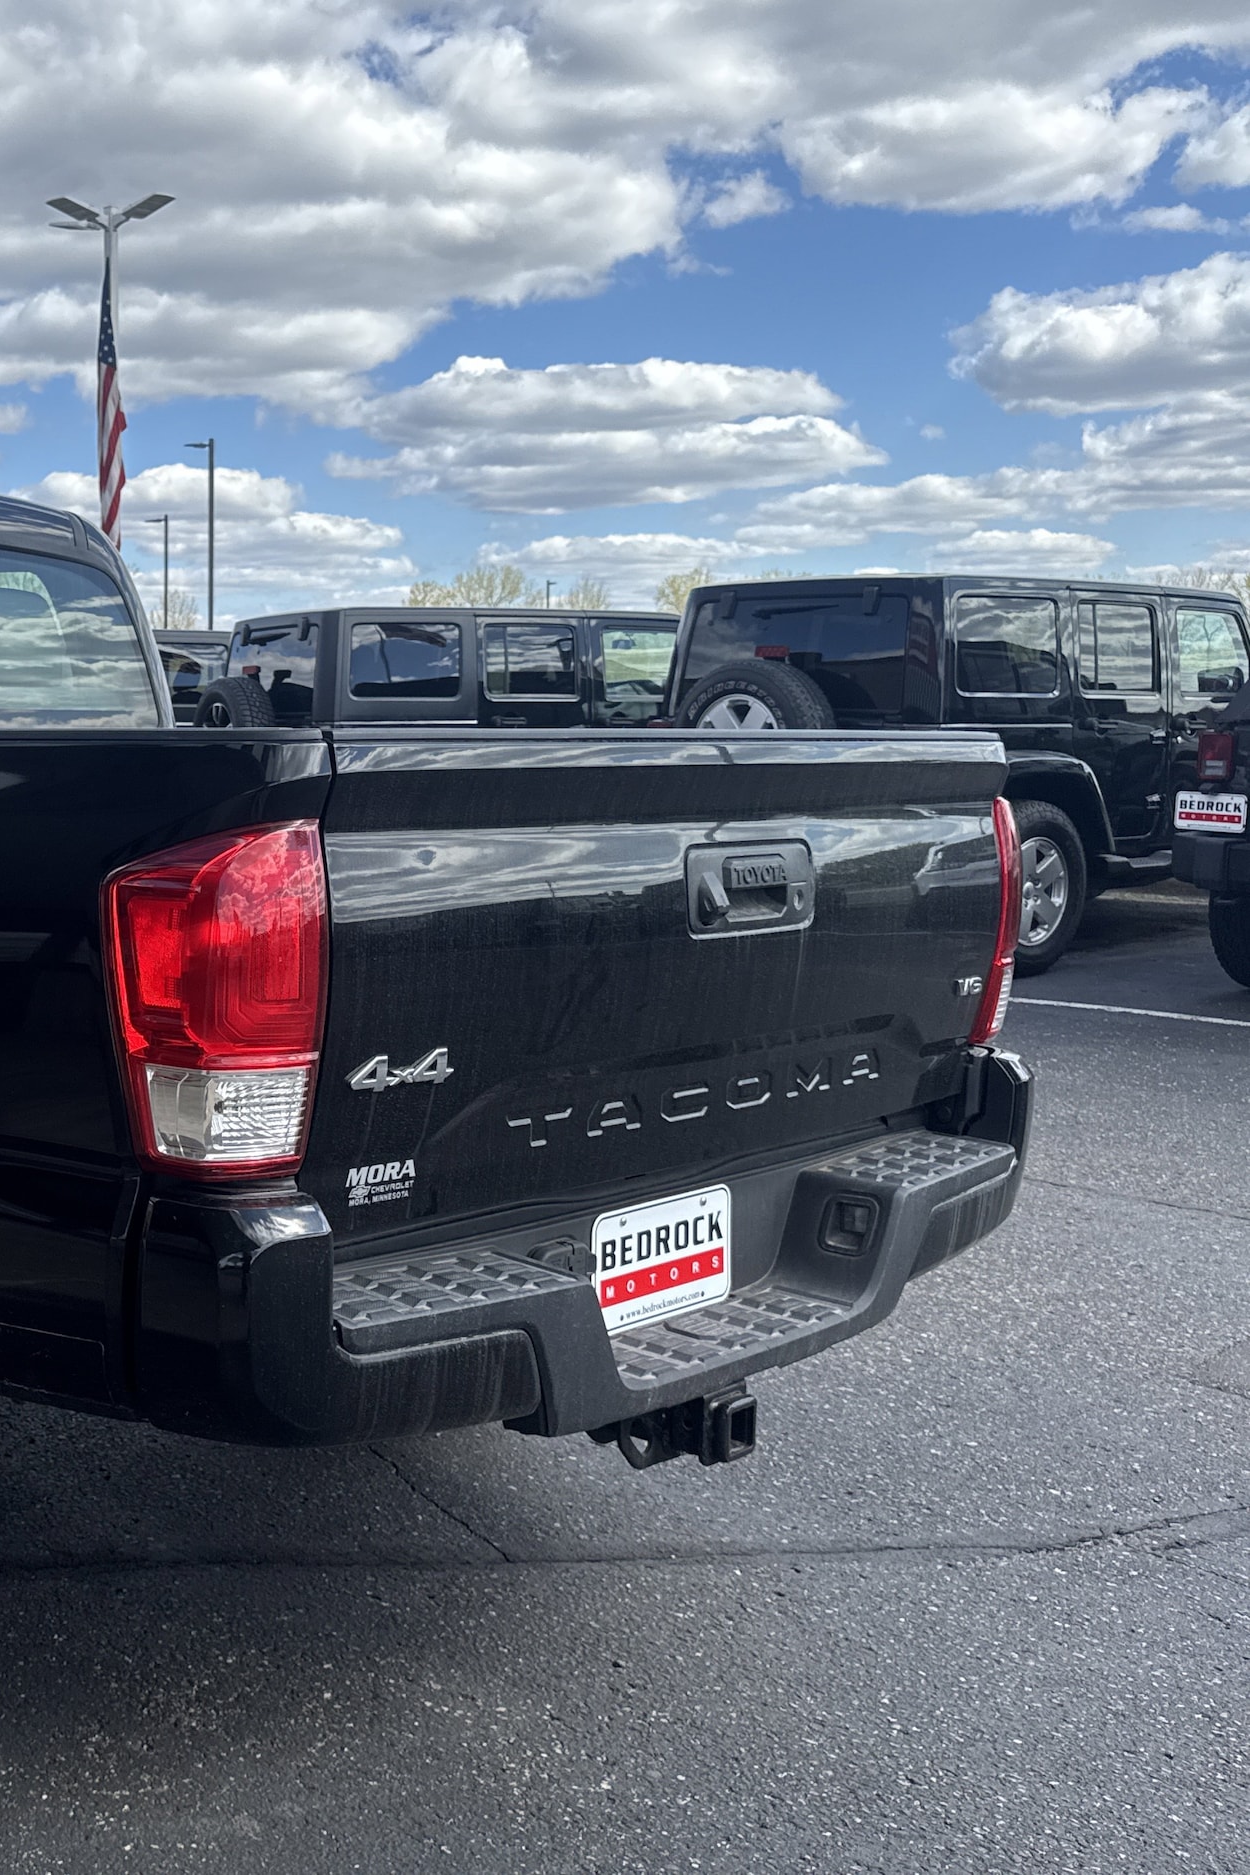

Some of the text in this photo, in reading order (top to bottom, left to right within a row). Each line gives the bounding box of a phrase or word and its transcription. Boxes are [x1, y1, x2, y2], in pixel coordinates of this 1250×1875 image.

[1180, 800, 1242, 812] BEDROCK
[734, 863, 787, 885] TOYOTA
[955, 976, 983, 996] V6
[506, 1048, 880, 1147] TACOMA
[345, 1159, 416, 1187] MORA
[348, 1190, 409, 1206] MORA, MINNESOTA
[370, 1179, 415, 1194] CHEVROLET
[601, 1210, 723, 1272] BEDROCK
[606, 1255, 719, 1298] MOTORS
[625, 1291, 700, 1319] www.bedrockmotors.com
